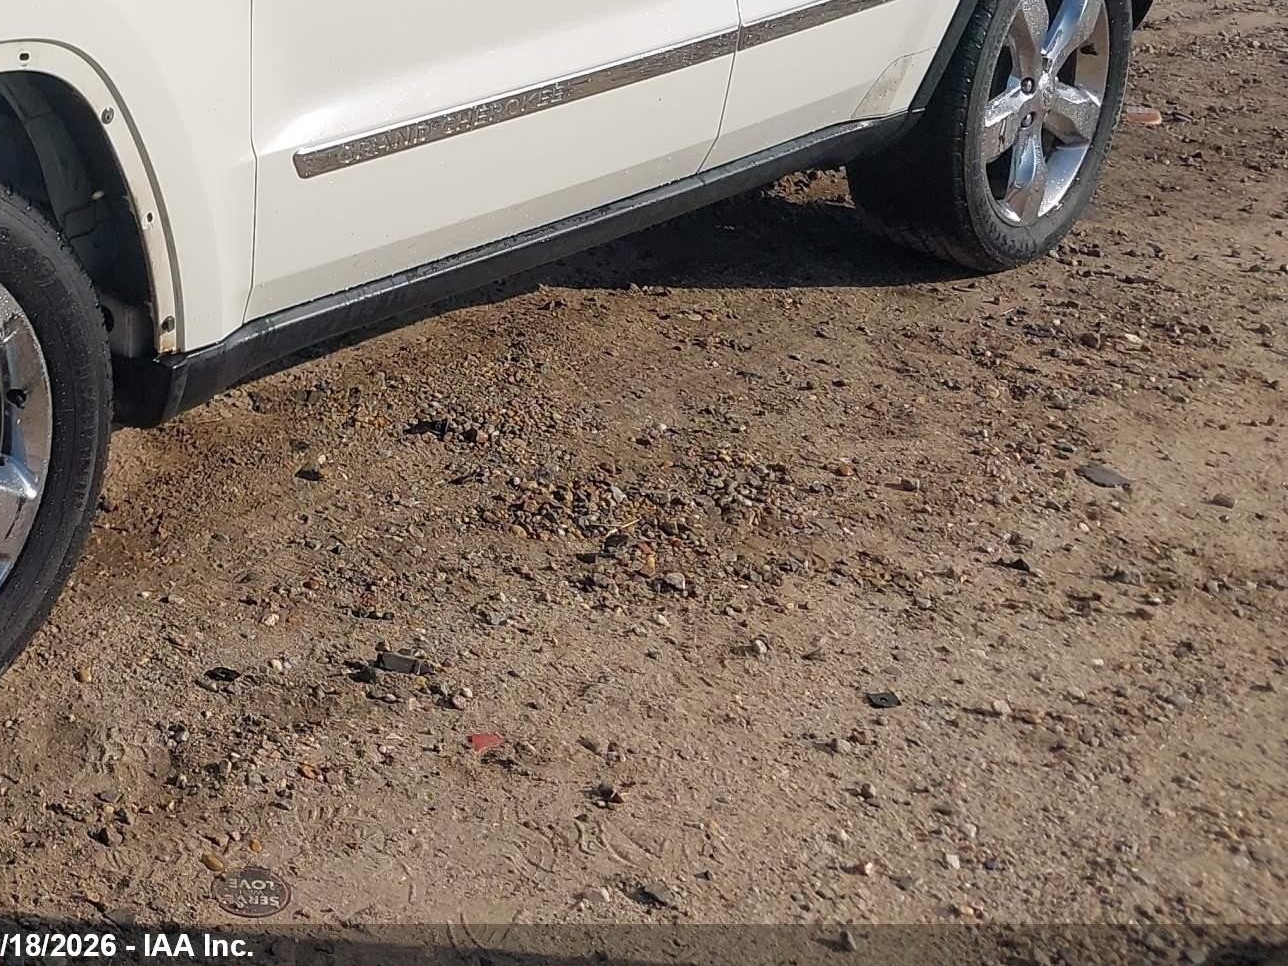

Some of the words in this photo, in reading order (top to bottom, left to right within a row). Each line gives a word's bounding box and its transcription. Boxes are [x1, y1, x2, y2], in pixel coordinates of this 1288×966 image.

[339, 122, 431, 164] GRAND
[441, 81, 566, 134] CHEROKEE
[228, 878, 275, 891] LOVE
